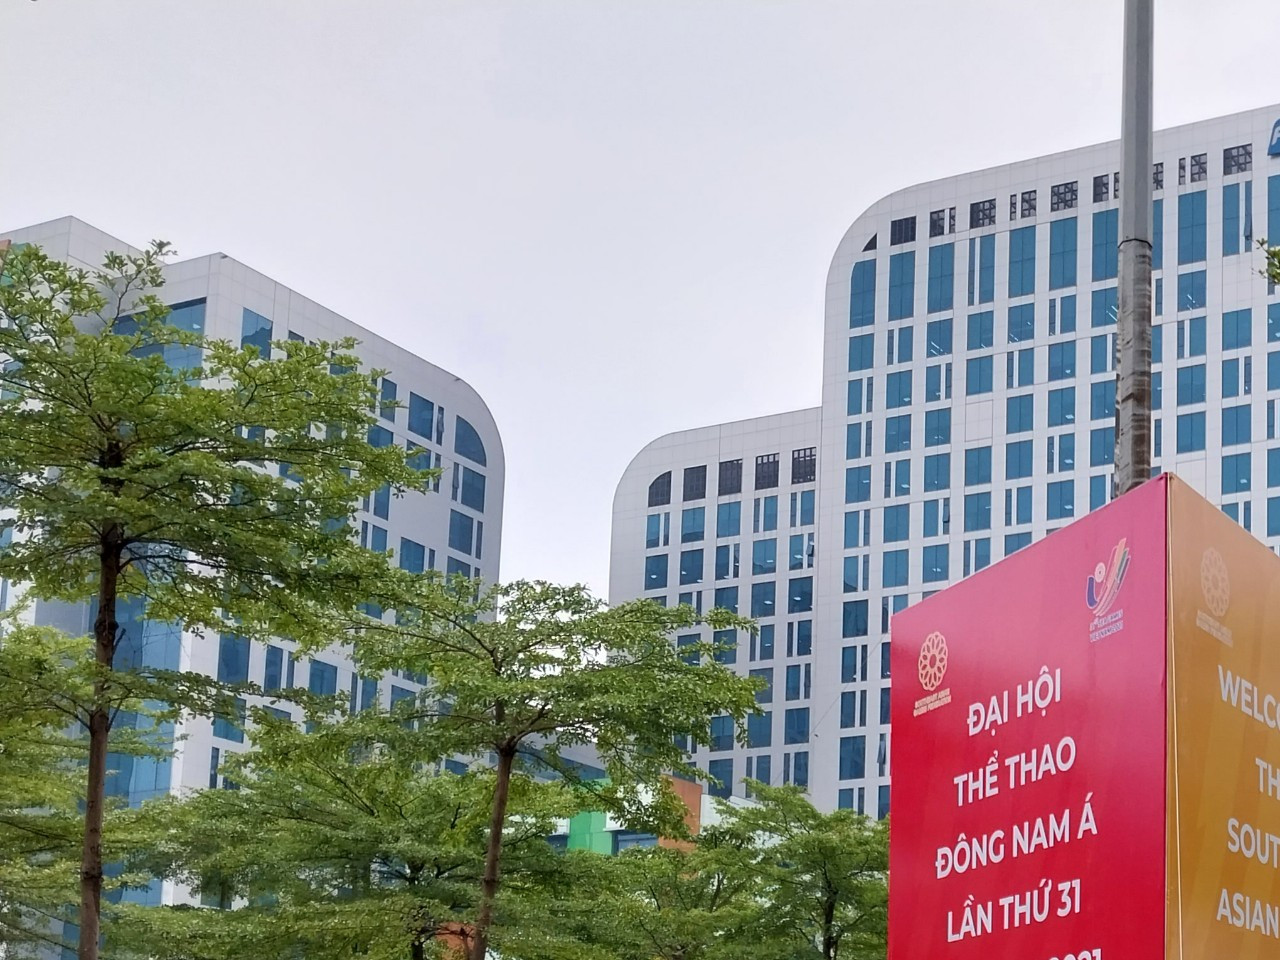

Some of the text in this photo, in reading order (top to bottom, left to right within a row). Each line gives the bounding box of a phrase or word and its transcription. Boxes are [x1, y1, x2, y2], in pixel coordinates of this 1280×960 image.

[966, 690, 1009, 737] ĐẠI
[1016, 665, 1062, 718] HỘI
[953, 735, 1076, 807] THỂ THAO
[934, 791, 1098, 880] ĐÔNG NAM Á
[947, 877, 1081, 943] LẦN THỨ 31
[1216, 887, 1279, 939] ASIAN
